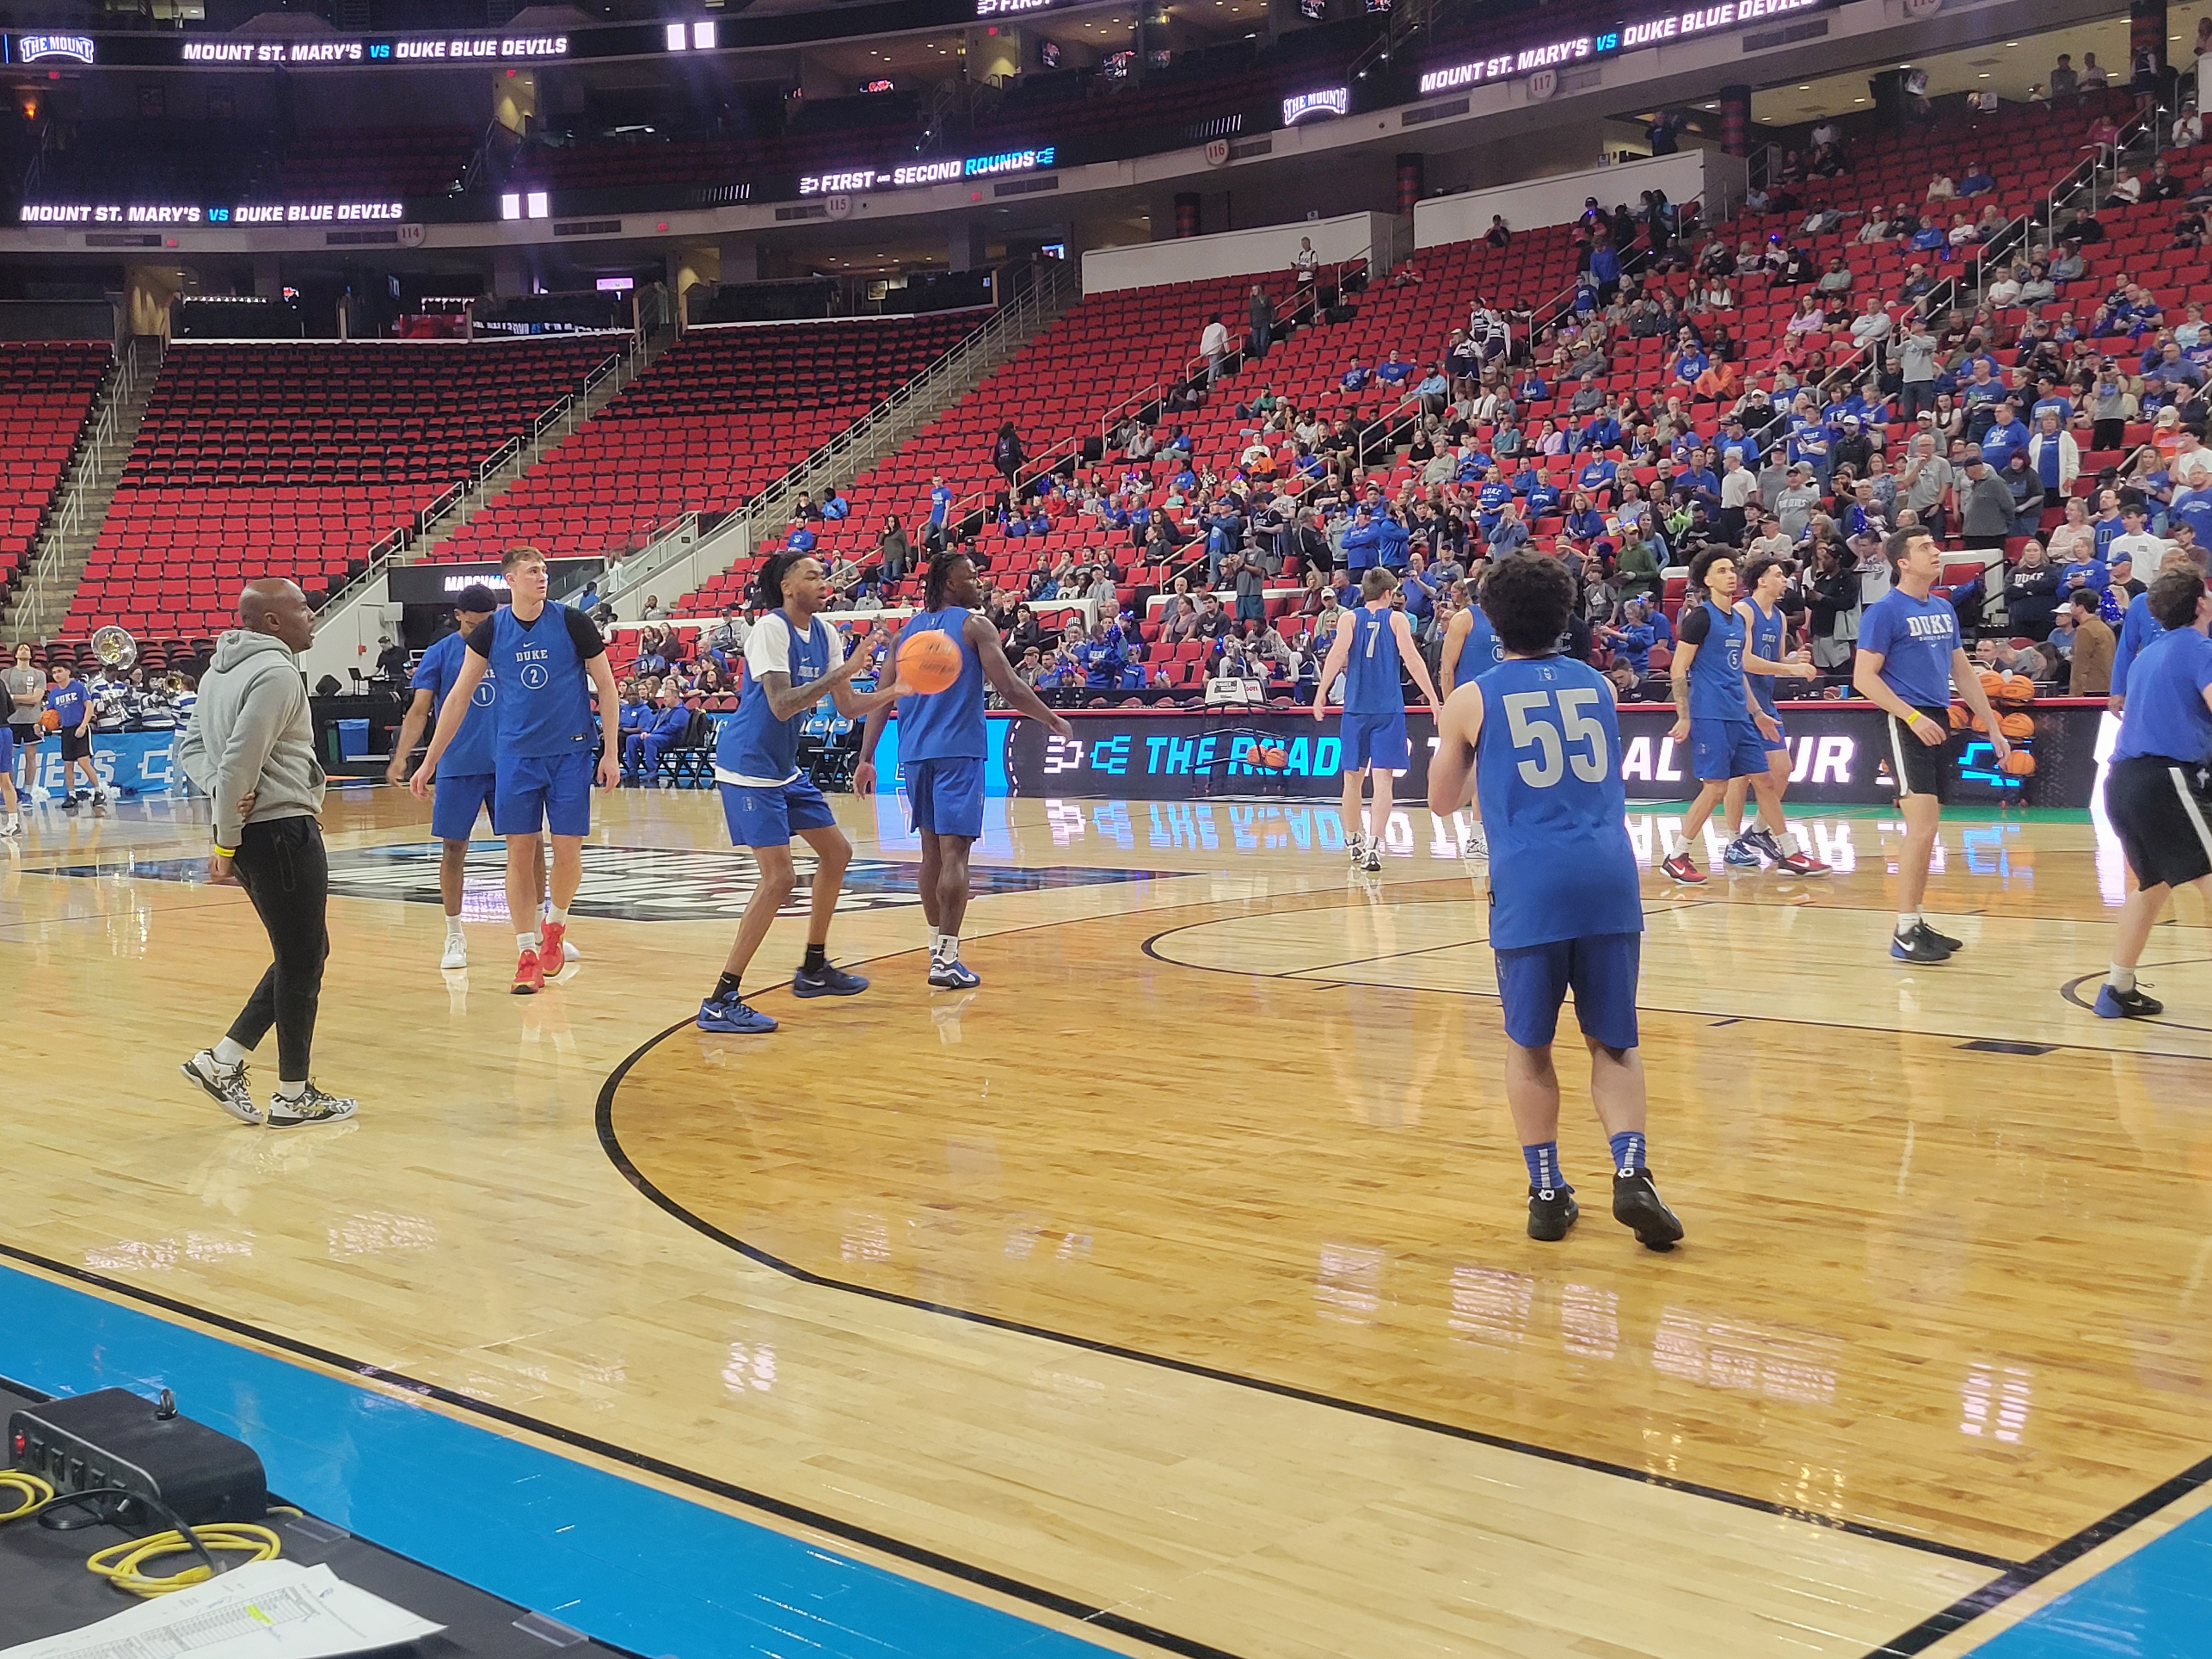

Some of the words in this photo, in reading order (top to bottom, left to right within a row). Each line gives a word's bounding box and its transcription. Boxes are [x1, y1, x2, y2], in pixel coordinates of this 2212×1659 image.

[22, 38, 47, 57] THE
[50, 36, 92, 57] MOUNT
[184, 44, 255, 60] MOUNT
[258, 44, 286, 61] ST.
[291, 44, 362, 61] MARY'S
[370, 44, 390, 59] VS
[397, 41, 445, 59] DUKE
[450, 41, 496, 57] BLUE
[501, 37, 567, 55] DEVILS
[1421, 61, 1483, 92] MOUNT
[1486, 55, 1513, 77] ST.
[1517, 38, 1588, 70] MARY'S
[1596, 33, 1617, 51] VS
[1623, 16, 1678, 47] DUKE
[1681, 4, 1733, 33] BLUE
[1533, 75, 1551, 91] 117
[1286, 95, 1306, 119] THE
[1308, 88, 1343, 109] MOUNT
[1209, 143, 1225, 159] 116
[821, 171, 875, 192] FIRST
[894, 160, 961, 184] SECOND
[965, 150, 1035, 176] ROUNDS
[21, 206, 92, 222] MOUNT
[95, 206, 123, 222] ST.
[128, 206, 201, 222] MARY'S
[208, 208, 229, 222] VS
[235, 207, 284, 222] DUKE
[287, 205, 334, 221] BLUE
[337, 203, 403, 219] DEVILS
[829, 199, 847, 210] 115
[402, 228, 420, 238] 114
[1906, 613, 1954, 637] DUKE
[1366, 622, 1380, 658] 7
[515, 649, 548, 663] DUKE
[1732, 653, 1738, 665] 5
[529, 669, 539, 684] 2
[56, 692, 78, 705] DUKE
[481, 687, 487, 701] 1
[1502, 687, 1609, 788] 55
[1146, 737, 1216, 775] THE
